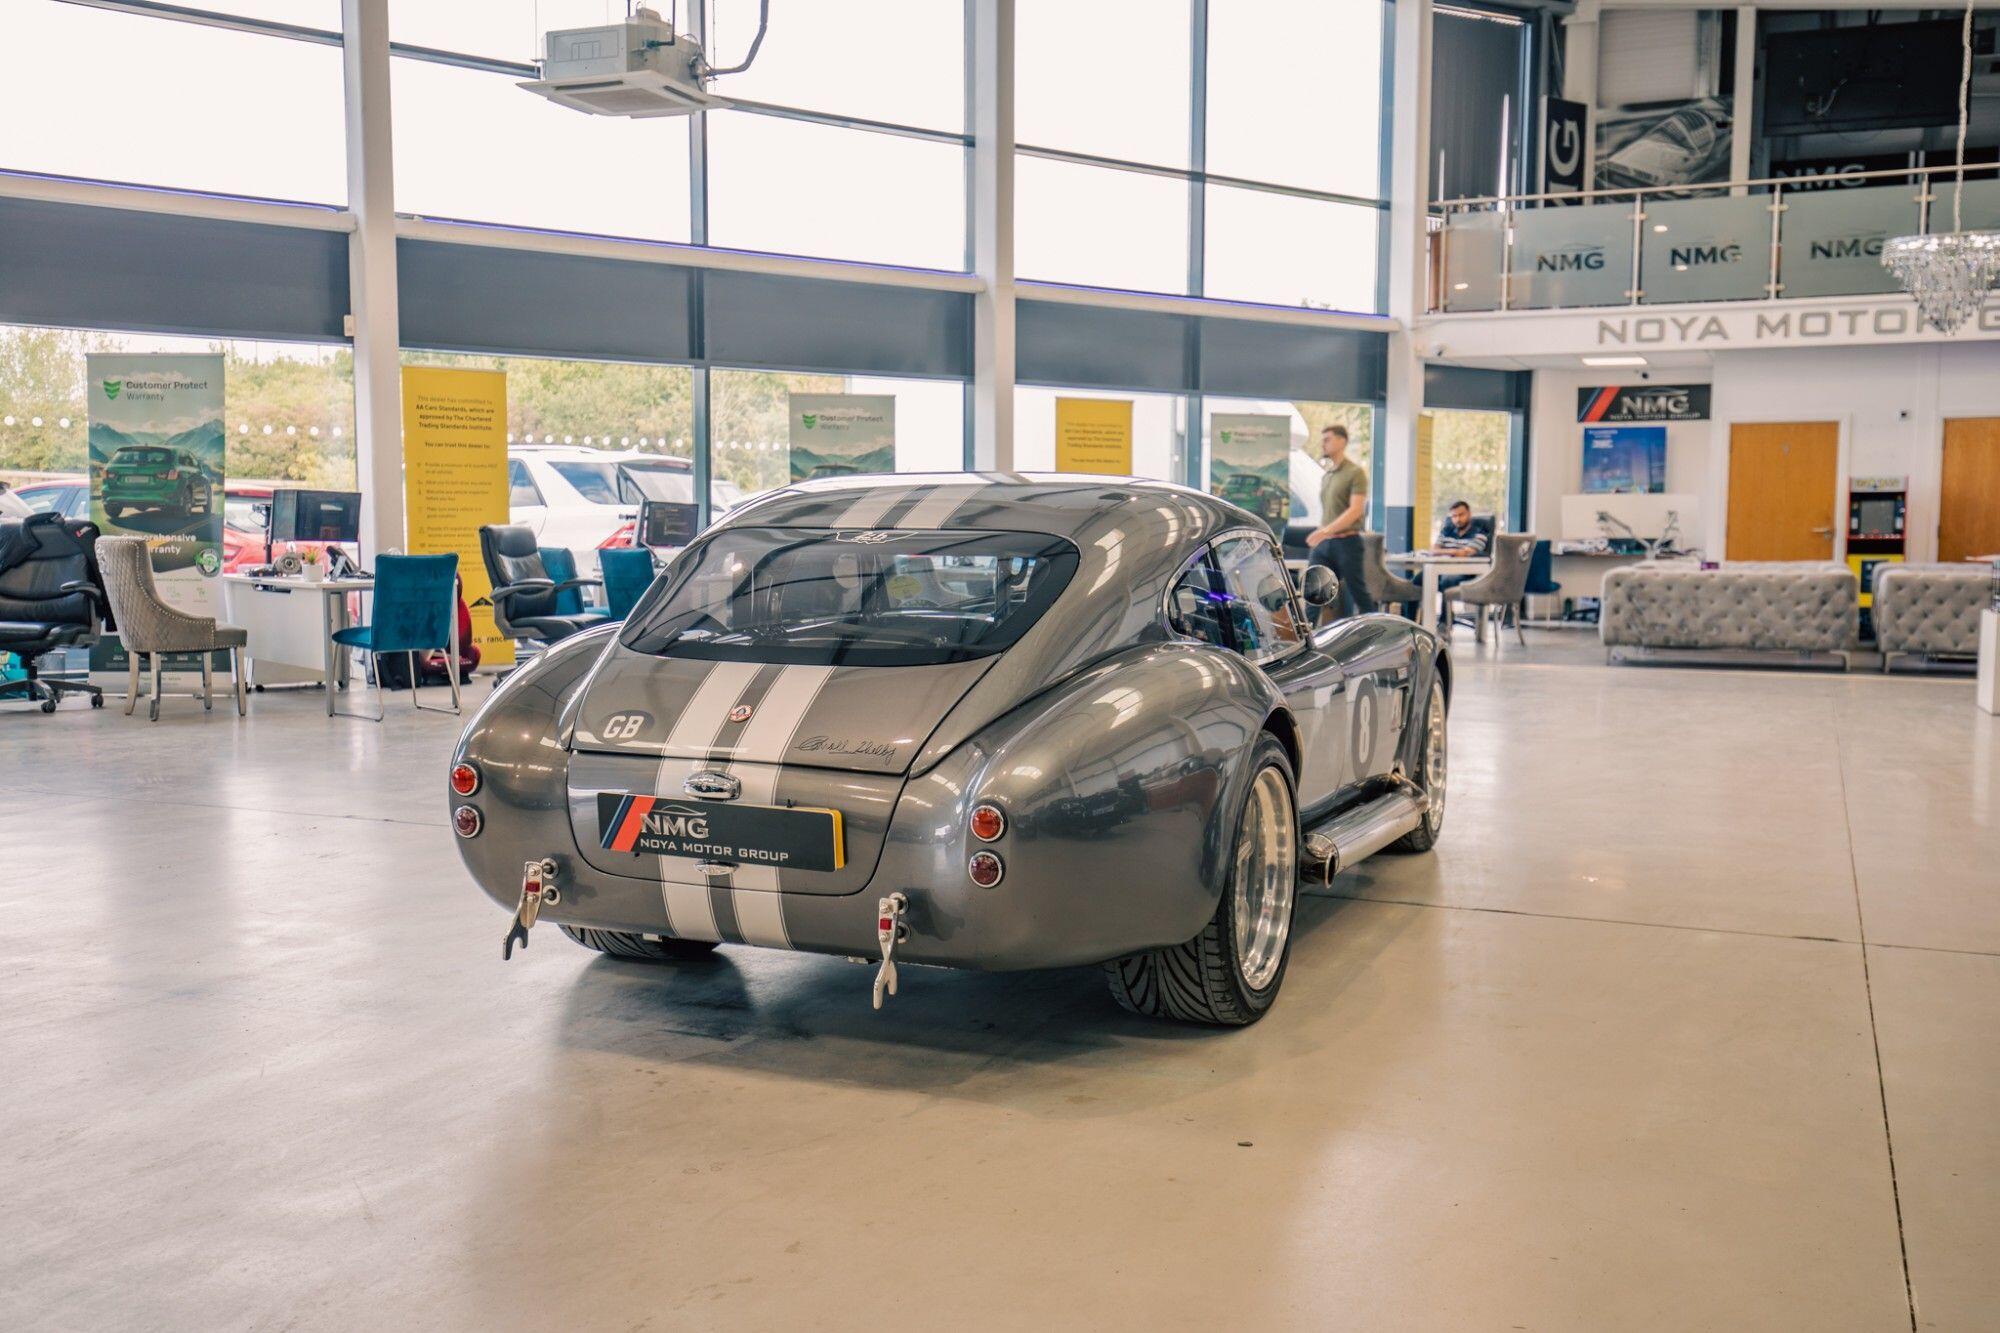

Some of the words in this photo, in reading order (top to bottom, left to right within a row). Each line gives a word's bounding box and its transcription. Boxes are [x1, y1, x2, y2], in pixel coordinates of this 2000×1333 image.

[1776, 164, 1866, 190] NMG
[1671, 245, 1742, 265] NMG
[1811, 238, 1885, 259] NMG
[1537, 252, 1604, 271] NMG
[1598, 316, 1728, 344] NOYA
[126, 381, 170, 390] Customer
[174, 382, 207, 390] Protect
[127, 393, 164, 402] Warranty
[1621, 395, 1689, 414] NMG
[603, 715, 645, 738] GB
[1359, 694, 1371, 764] 8
[640, 812, 709, 839] NMG
[640, 838, 678, 852] NOYA
[683, 842, 732, 856] MOTOR
[739, 848, 789, 862] GROUP
